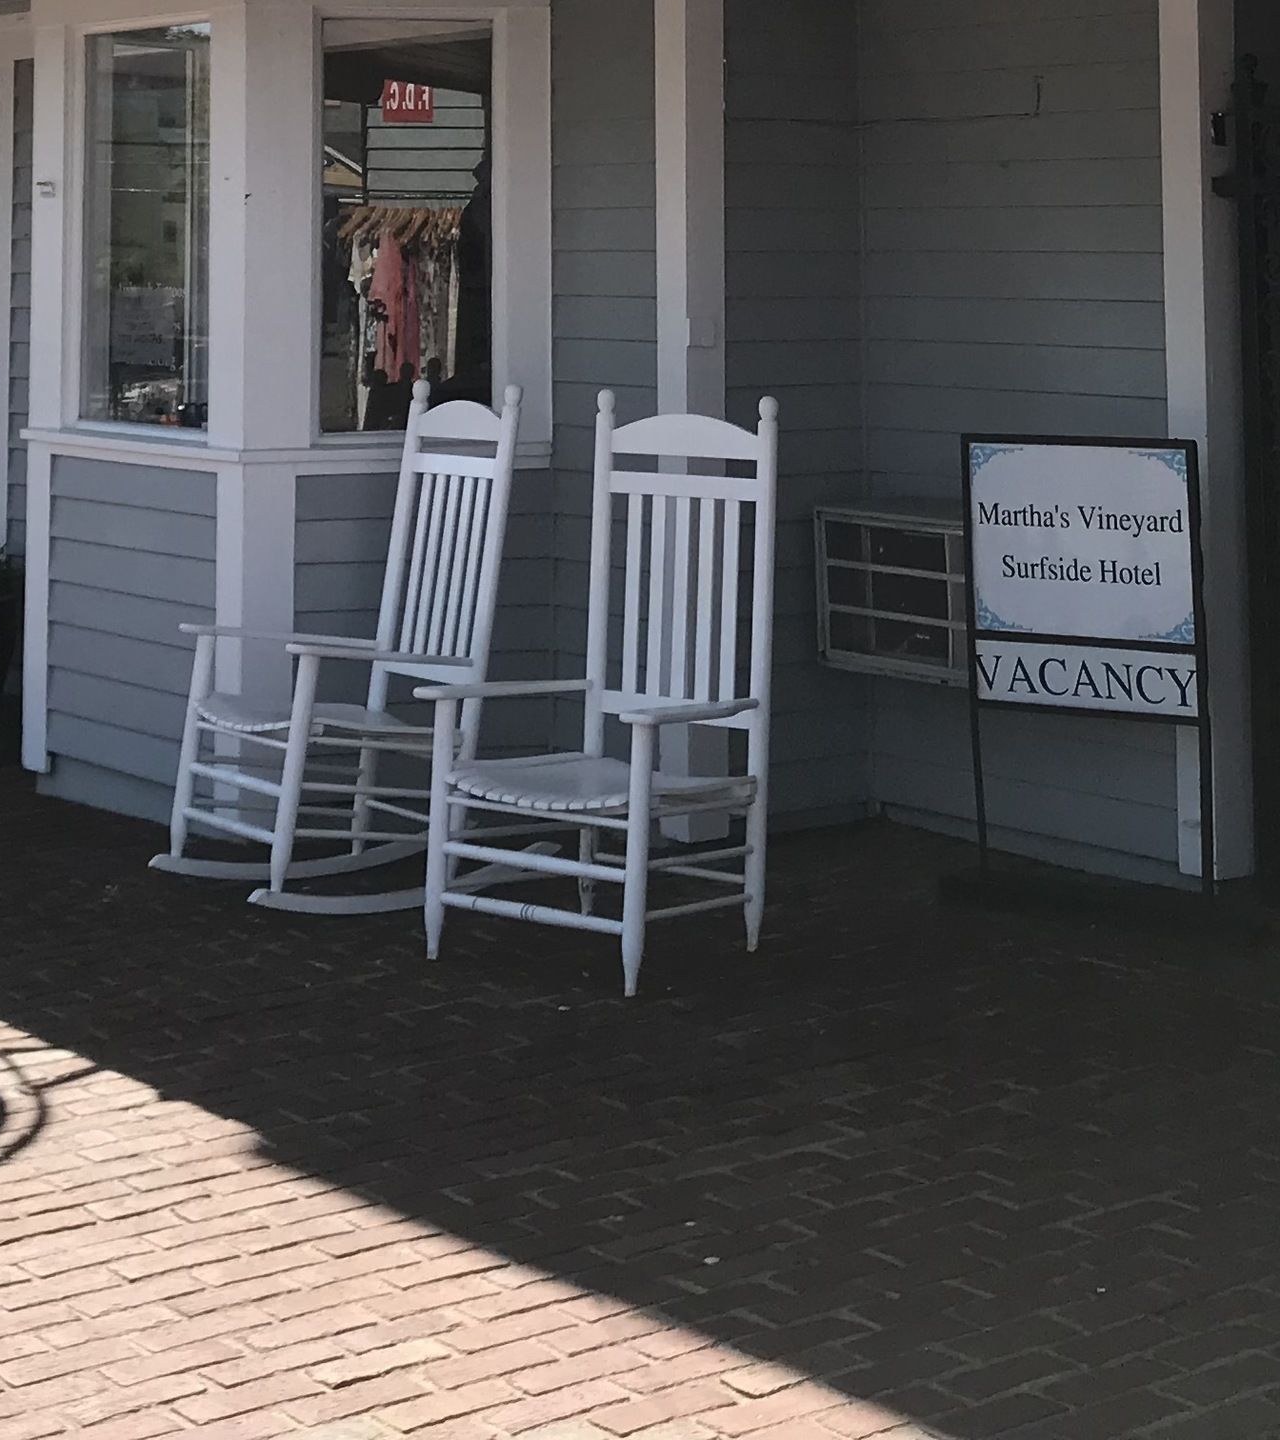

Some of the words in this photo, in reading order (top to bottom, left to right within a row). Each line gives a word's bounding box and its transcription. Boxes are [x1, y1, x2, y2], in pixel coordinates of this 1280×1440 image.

[977, 502, 1070, 528] Martha's
[1078, 506, 1184, 538] Vineyard
[1002, 554, 1092, 582] Surfside
[1099, 560, 1162, 586] Hotel
[976, 654, 1197, 708] VACANCY
